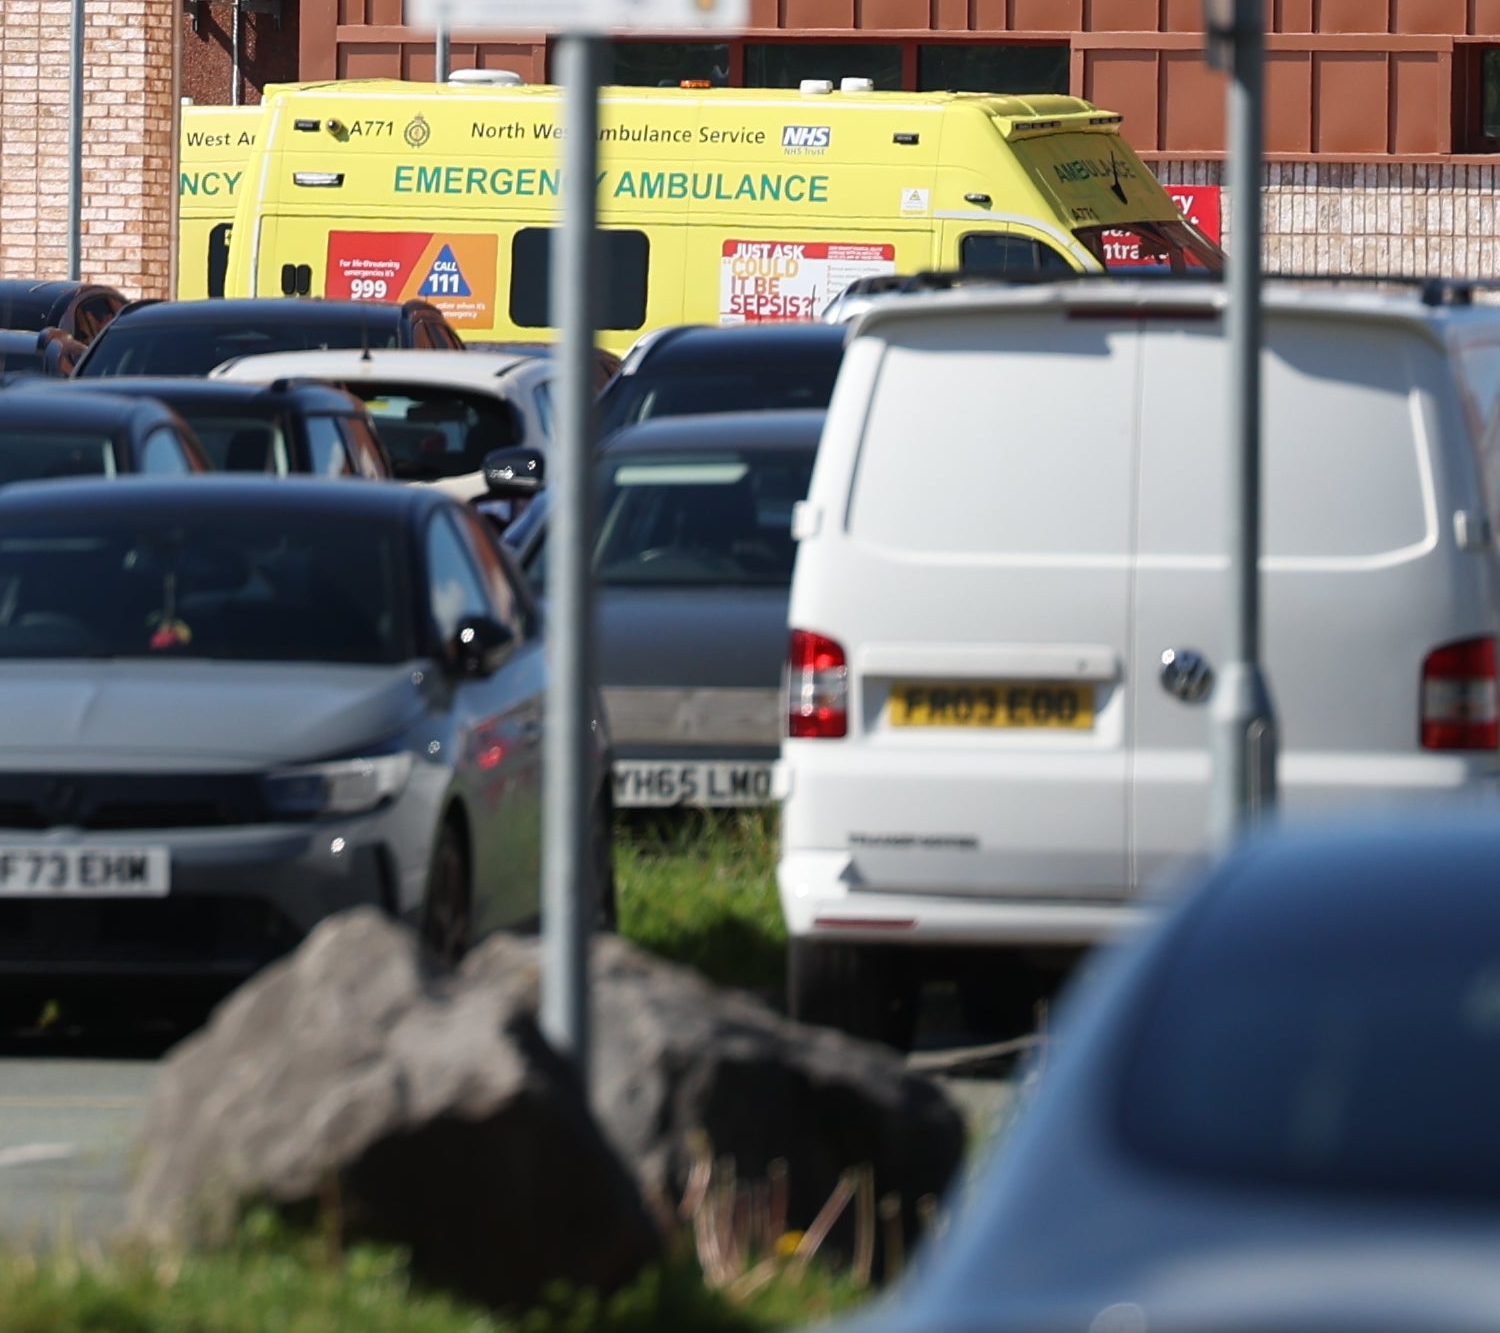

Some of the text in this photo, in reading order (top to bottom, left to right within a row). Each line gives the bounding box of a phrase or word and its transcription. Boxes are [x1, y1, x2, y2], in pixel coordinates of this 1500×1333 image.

[186, 131, 232, 147] West
[350, 120, 395, 137] A771
[471, 122, 526, 139] North
[598, 124, 692, 144] mbulance
[699, 125, 766, 145] Service
[783, 126, 829, 148] NHS
[394, 165, 829, 203] EMERGENY AMBULANCE
[733, 242, 806, 260] JUST ASK
[339, 259, 351, 268] For
[433, 261, 458, 272] CALL
[351, 279, 387, 299] 999
[429, 274, 459, 294] 111
[731, 276, 780, 296] IT BE
